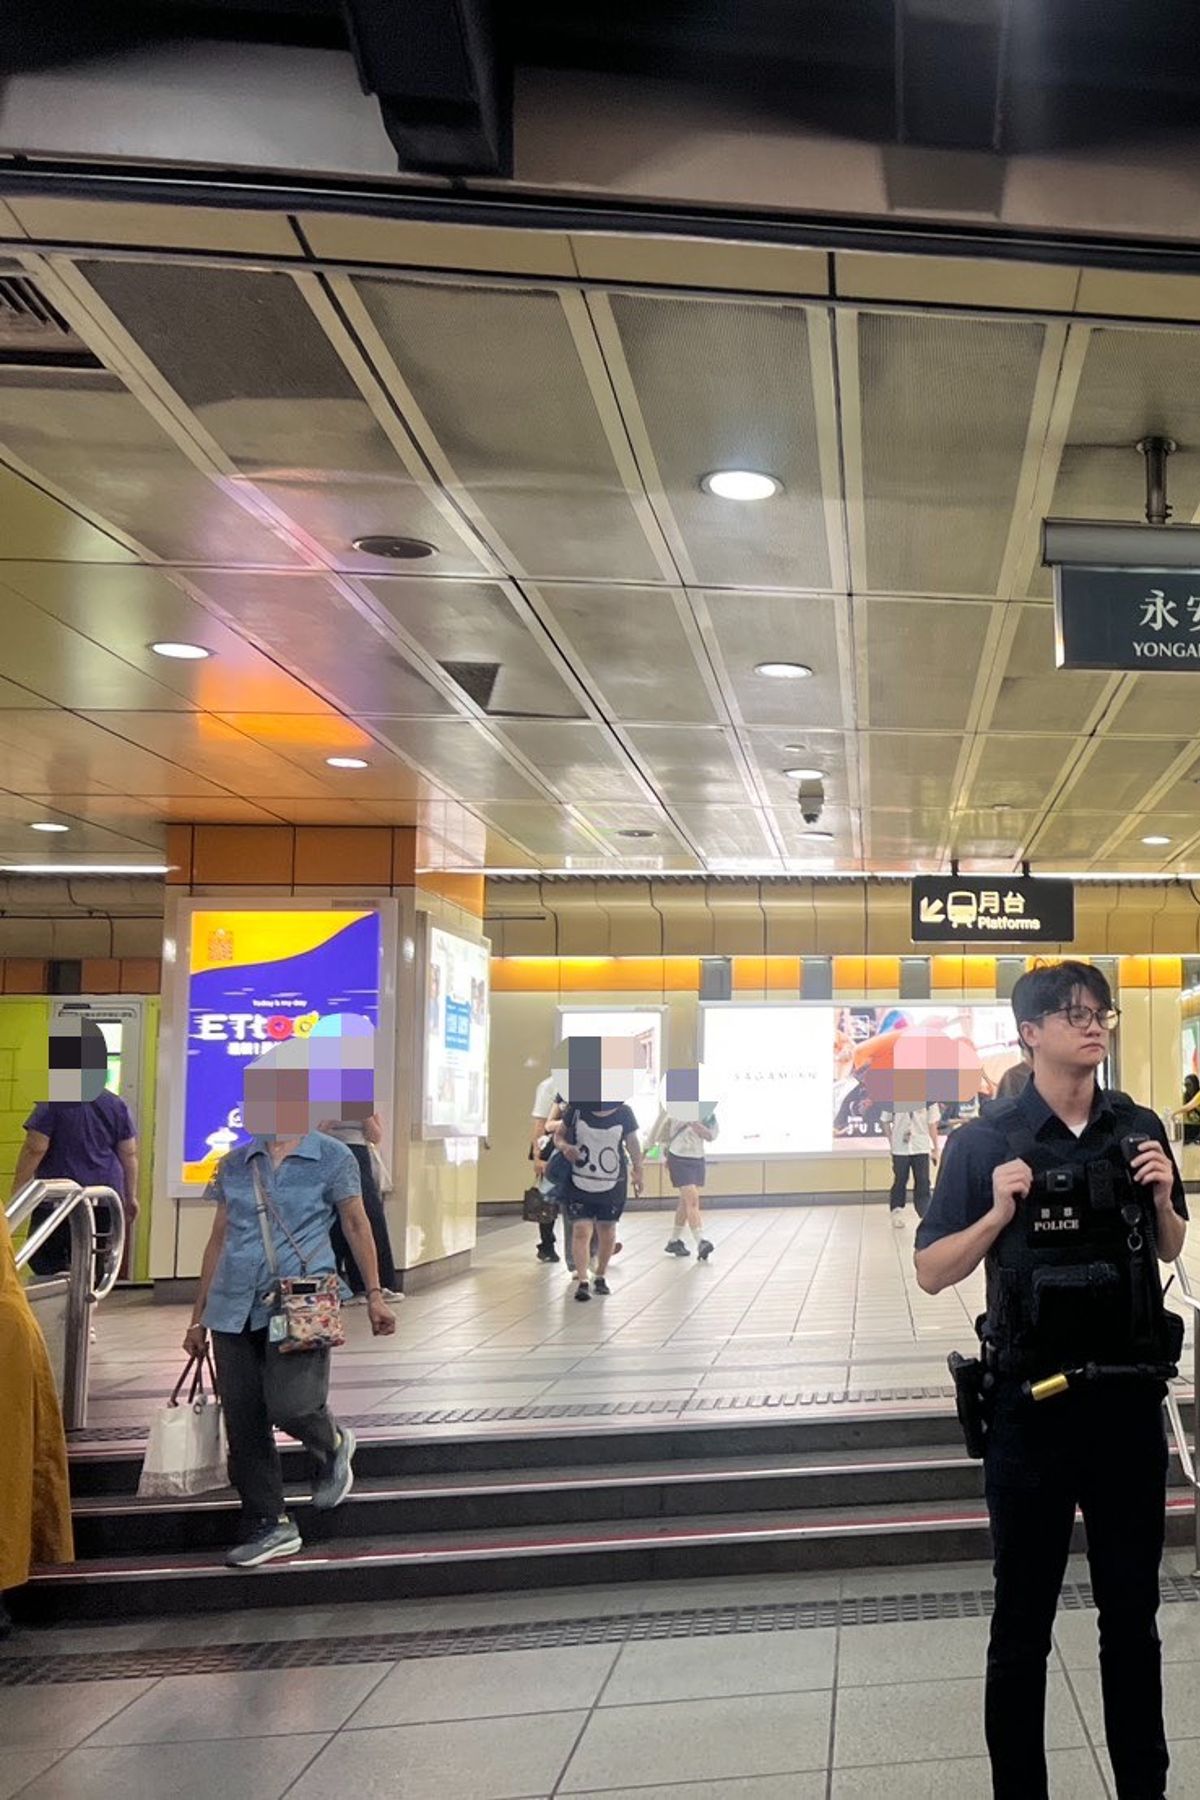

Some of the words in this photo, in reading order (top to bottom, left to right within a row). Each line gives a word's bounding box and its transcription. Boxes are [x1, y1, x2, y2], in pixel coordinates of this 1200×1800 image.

[978, 890, 1026, 914] 月台
[977, 916, 1041, 930] Platforms
[1034, 1219, 1079, 1232] POLICE
